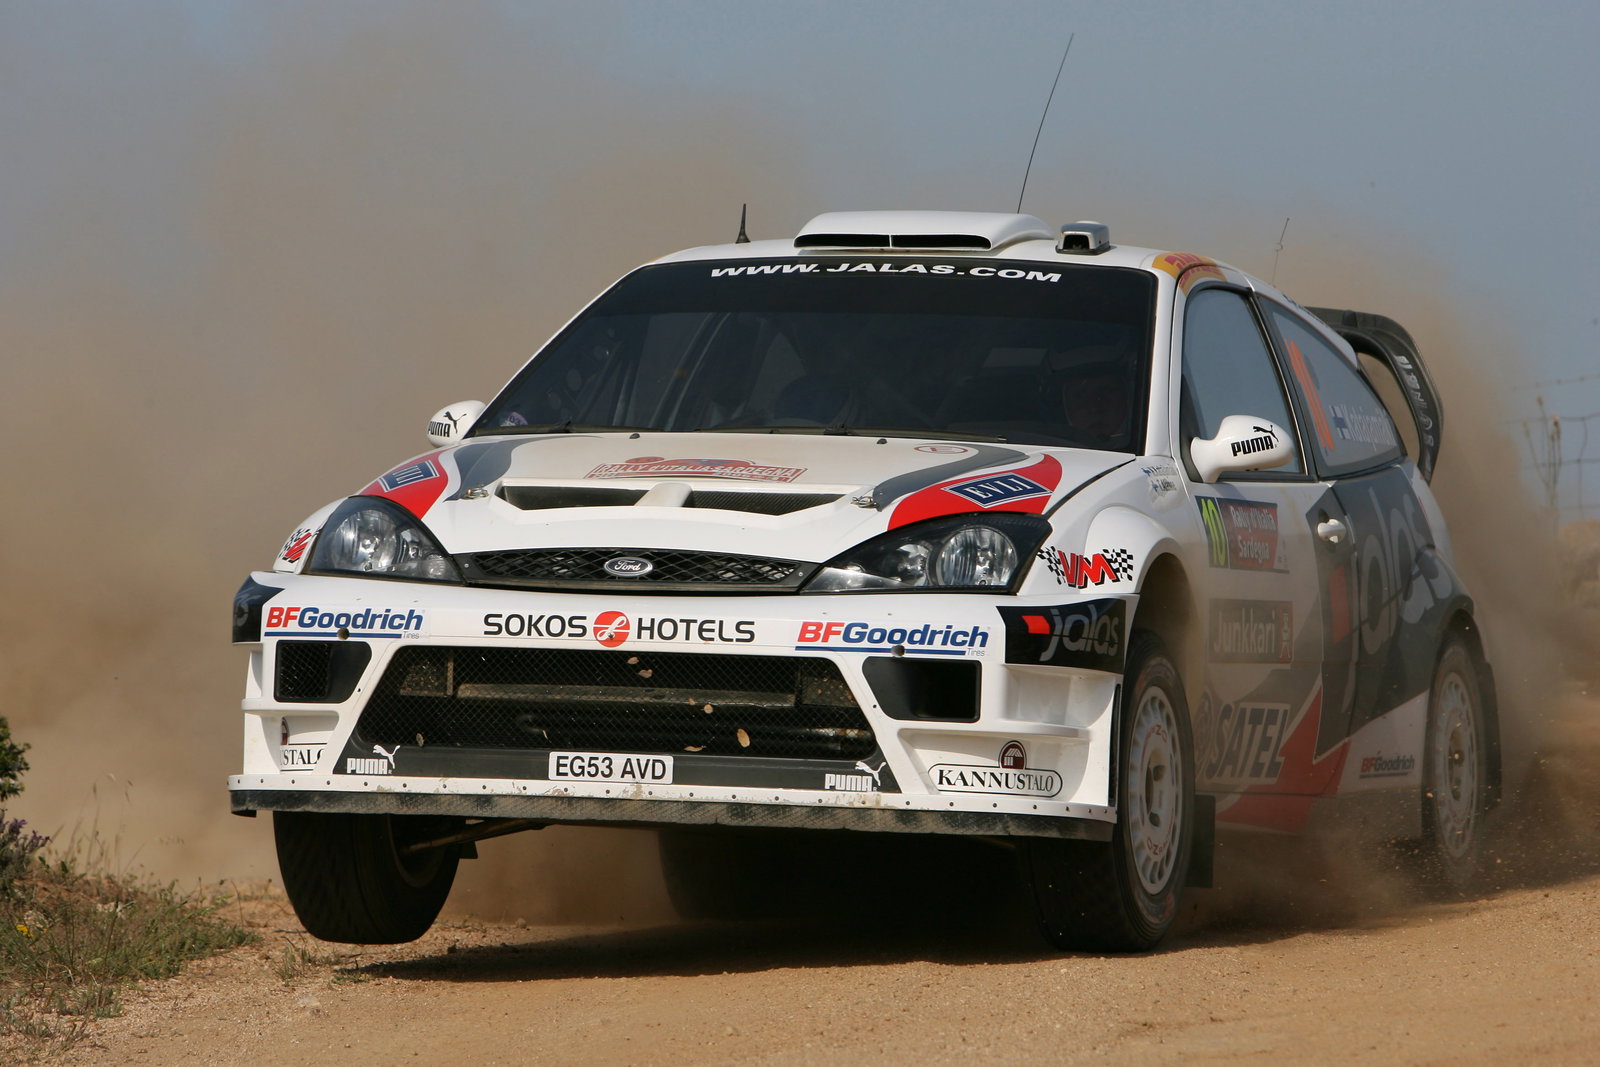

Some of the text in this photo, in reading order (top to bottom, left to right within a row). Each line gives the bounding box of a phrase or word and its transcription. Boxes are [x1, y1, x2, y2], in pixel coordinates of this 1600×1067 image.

[428, 421, 451, 438] PUMA
[1231, 435, 1273, 457] PUMA
[595, 463, 648, 474] RALLY
[963, 478, 1034, 499] EVLI
[1230, 505, 1252, 532] Rally
[1200, 498, 1226, 567] 10
[1237, 536, 1270, 564] Sardegna
[614, 560, 642, 573] Ford
[1057, 550, 1119, 589] VM
[265, 606, 423, 630] BFGoodrich
[483, 613, 756, 643] SOKOS HOTELS
[403, 631, 420, 640] Tires
[797, 621, 990, 649] BFGoodrich
[1039, 604, 1119, 662] jalas
[1213, 608, 1276, 654] Junkkari
[967, 648, 985, 657] Tires
[1205, 703, 1289, 780] SATEL
[281, 748, 325, 766] STAL
[347, 758, 388, 775] PUMA
[556, 756, 666, 780] EG53 AVD
[1361, 754, 1415, 773] BFGoodrich
[825, 774, 873, 792] PUMA
[938, 769, 1054, 792] KANNUSTALO
